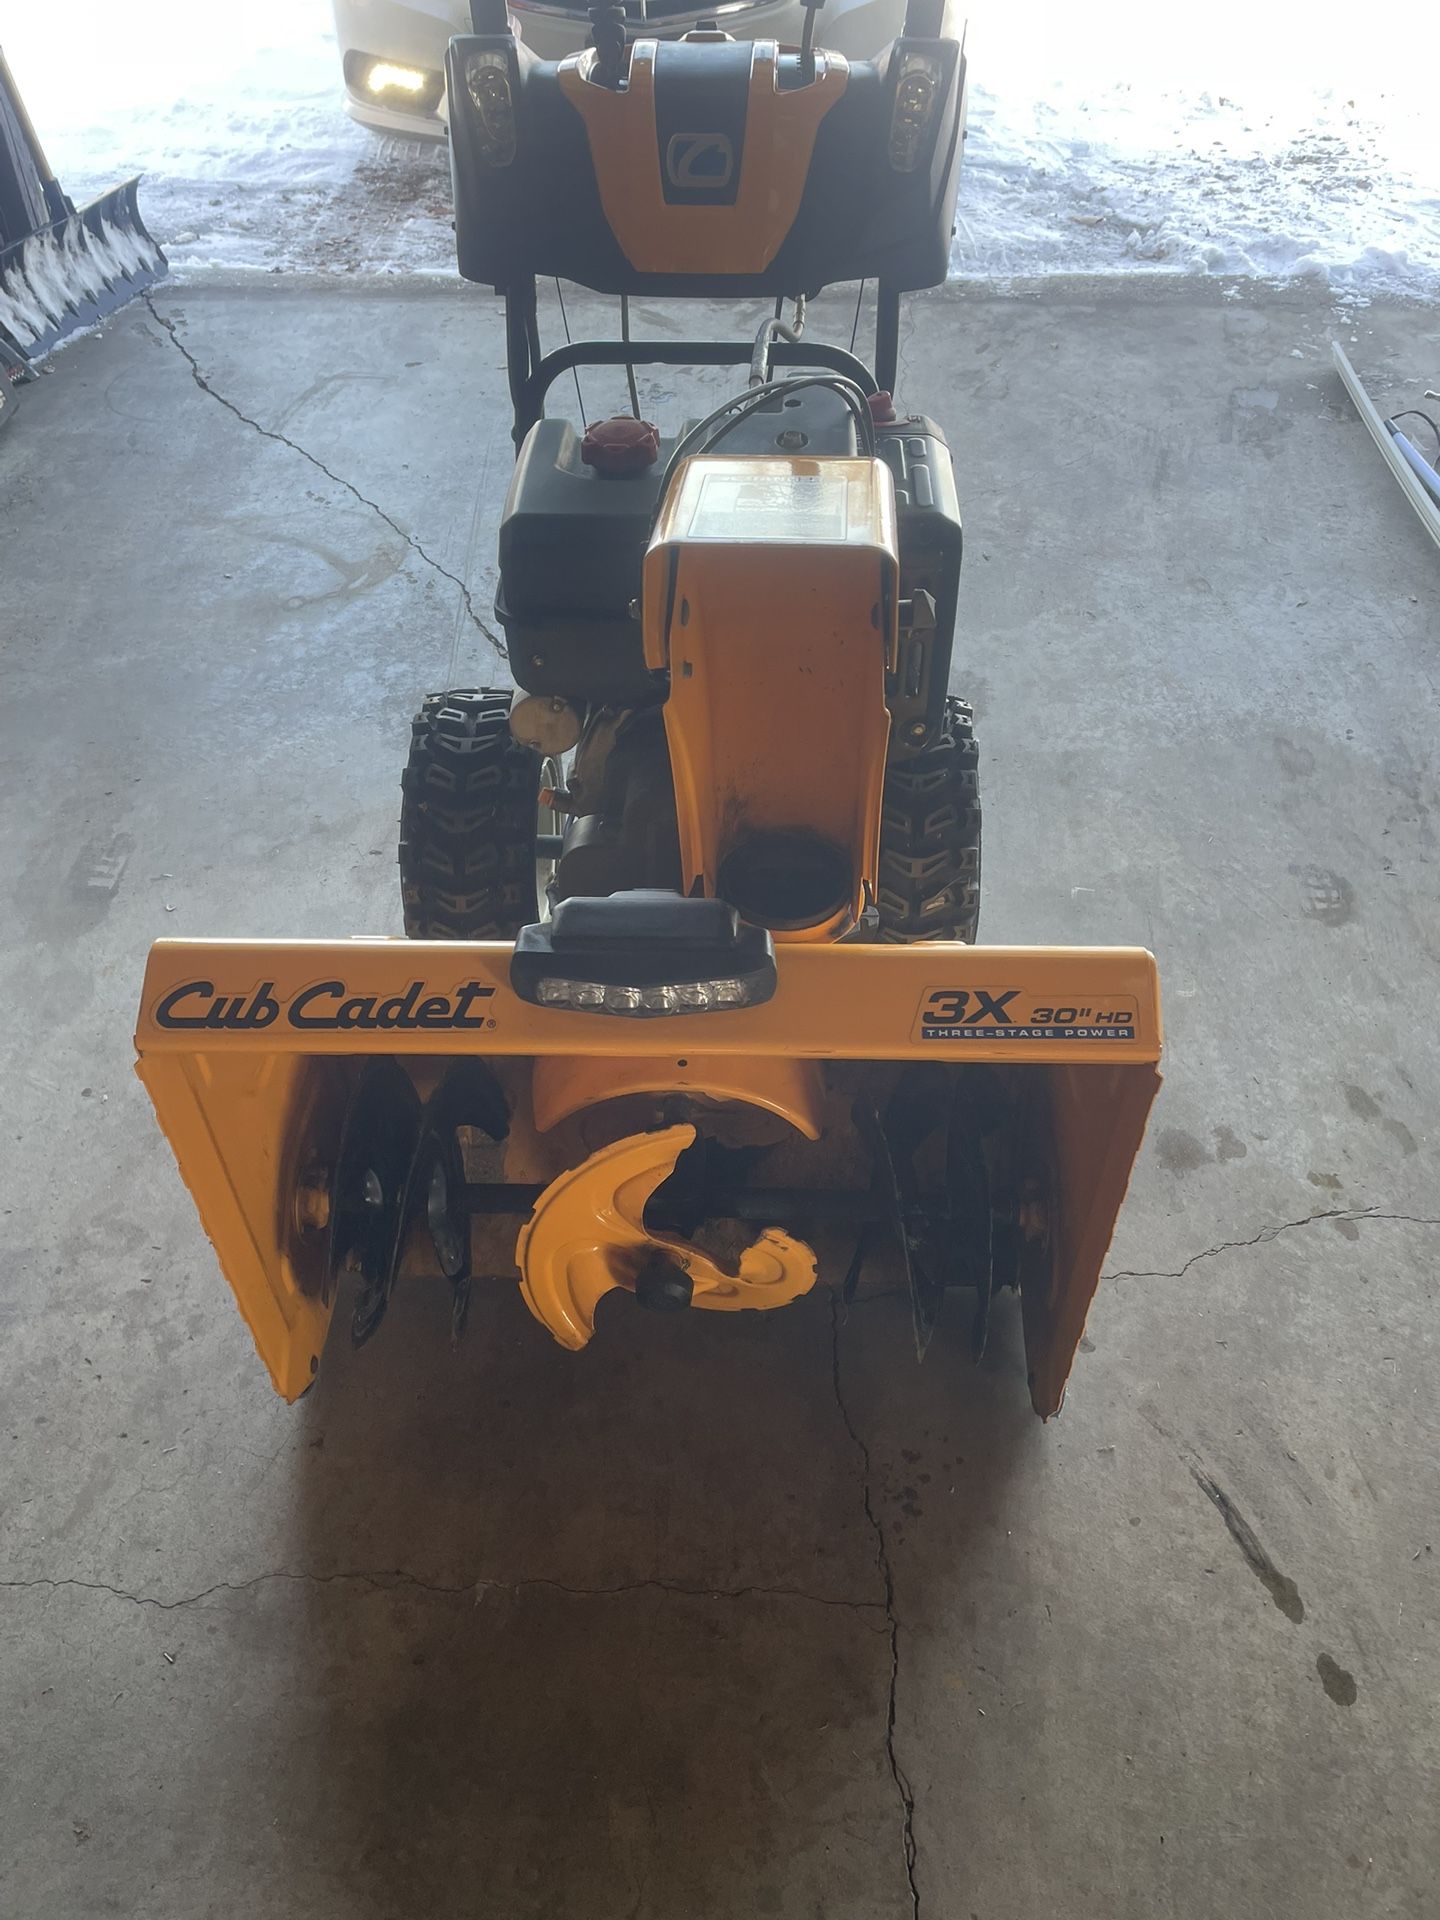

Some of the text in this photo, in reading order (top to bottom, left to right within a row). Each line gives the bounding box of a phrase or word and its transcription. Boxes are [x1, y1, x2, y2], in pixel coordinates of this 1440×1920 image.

[155, 981, 280, 1029] Cub
[922, 990, 1133, 1025] 3X 30" HD
[926, 1028, 1129, 1037] THREE-STAGE POWER
